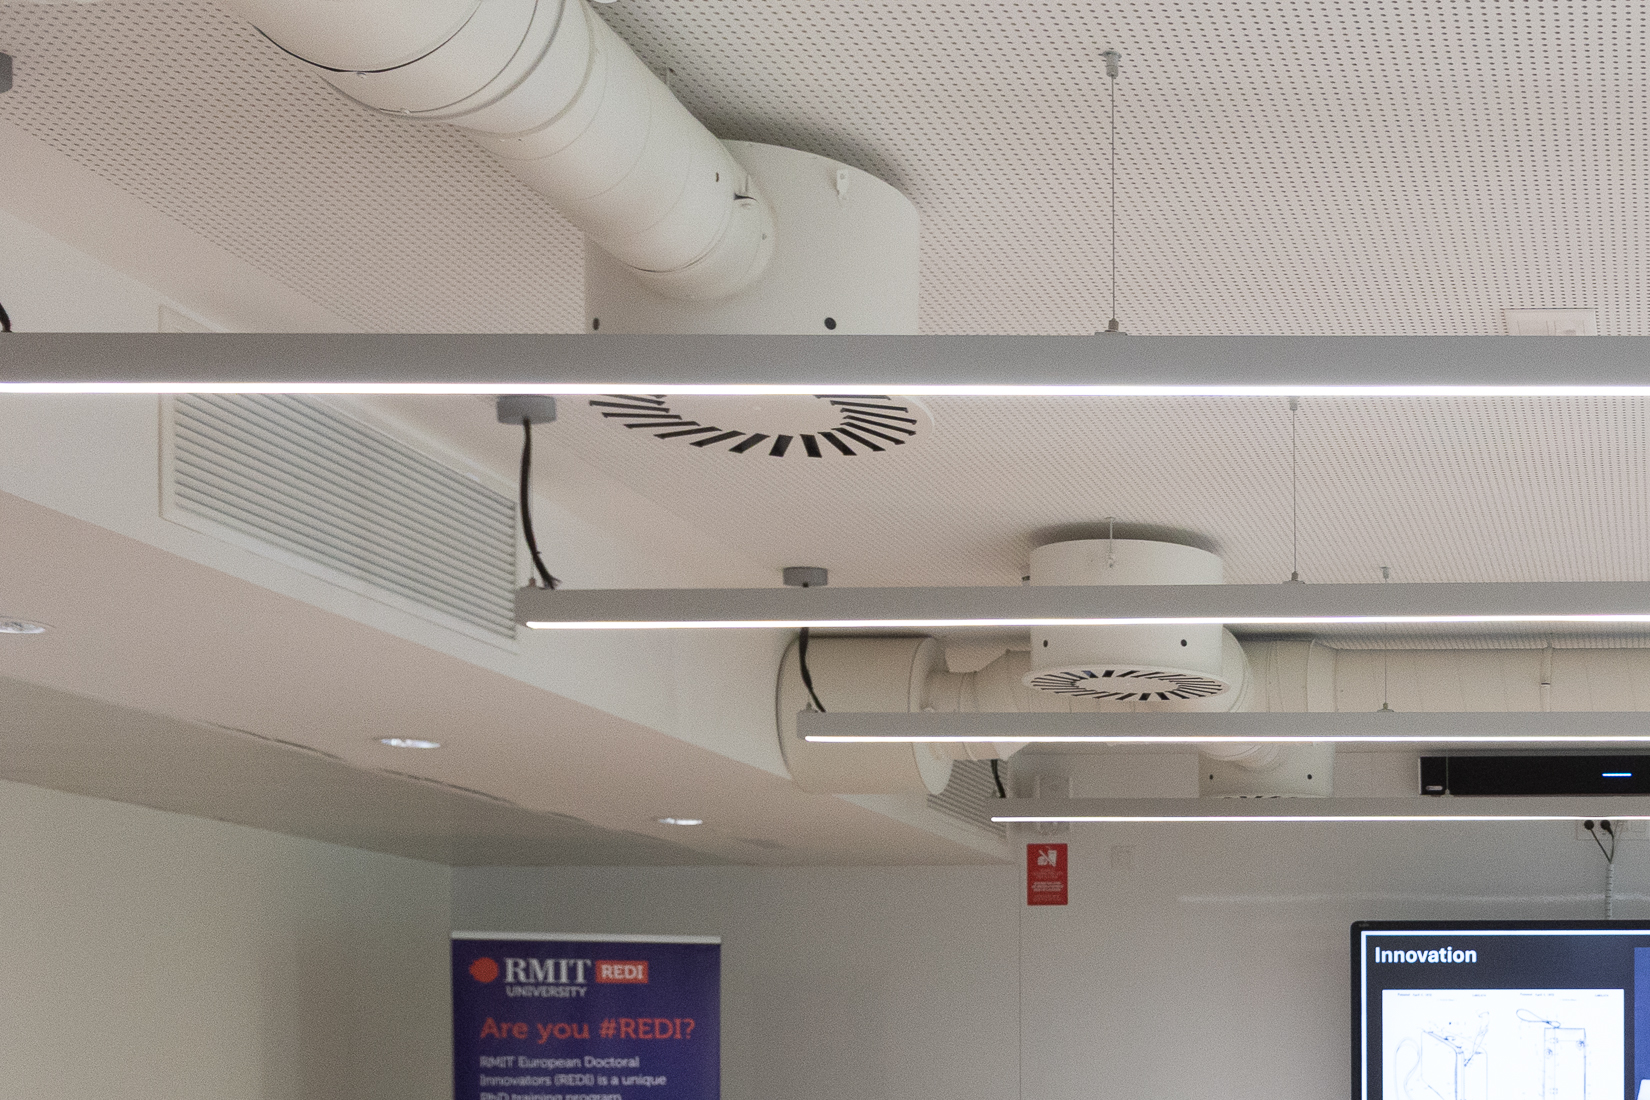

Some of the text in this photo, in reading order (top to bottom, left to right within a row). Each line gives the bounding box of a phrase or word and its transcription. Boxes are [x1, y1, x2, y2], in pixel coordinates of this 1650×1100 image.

[1374, 945, 1478, 965] Innovation
[504, 957, 591, 984] RMIT
[601, 964, 644, 979] REDI
[506, 986, 588, 998] UNIVERSITY
[480, 1017, 696, 1044] Are you #REDI?
[480, 1056, 639, 1070] RMIT European Doctoral
[480, 1074, 551, 1086] Innovators
[597, 1074, 609, 1086] is
[611, 1077, 619, 1086] a
[622, 1075, 667, 1088] unique
